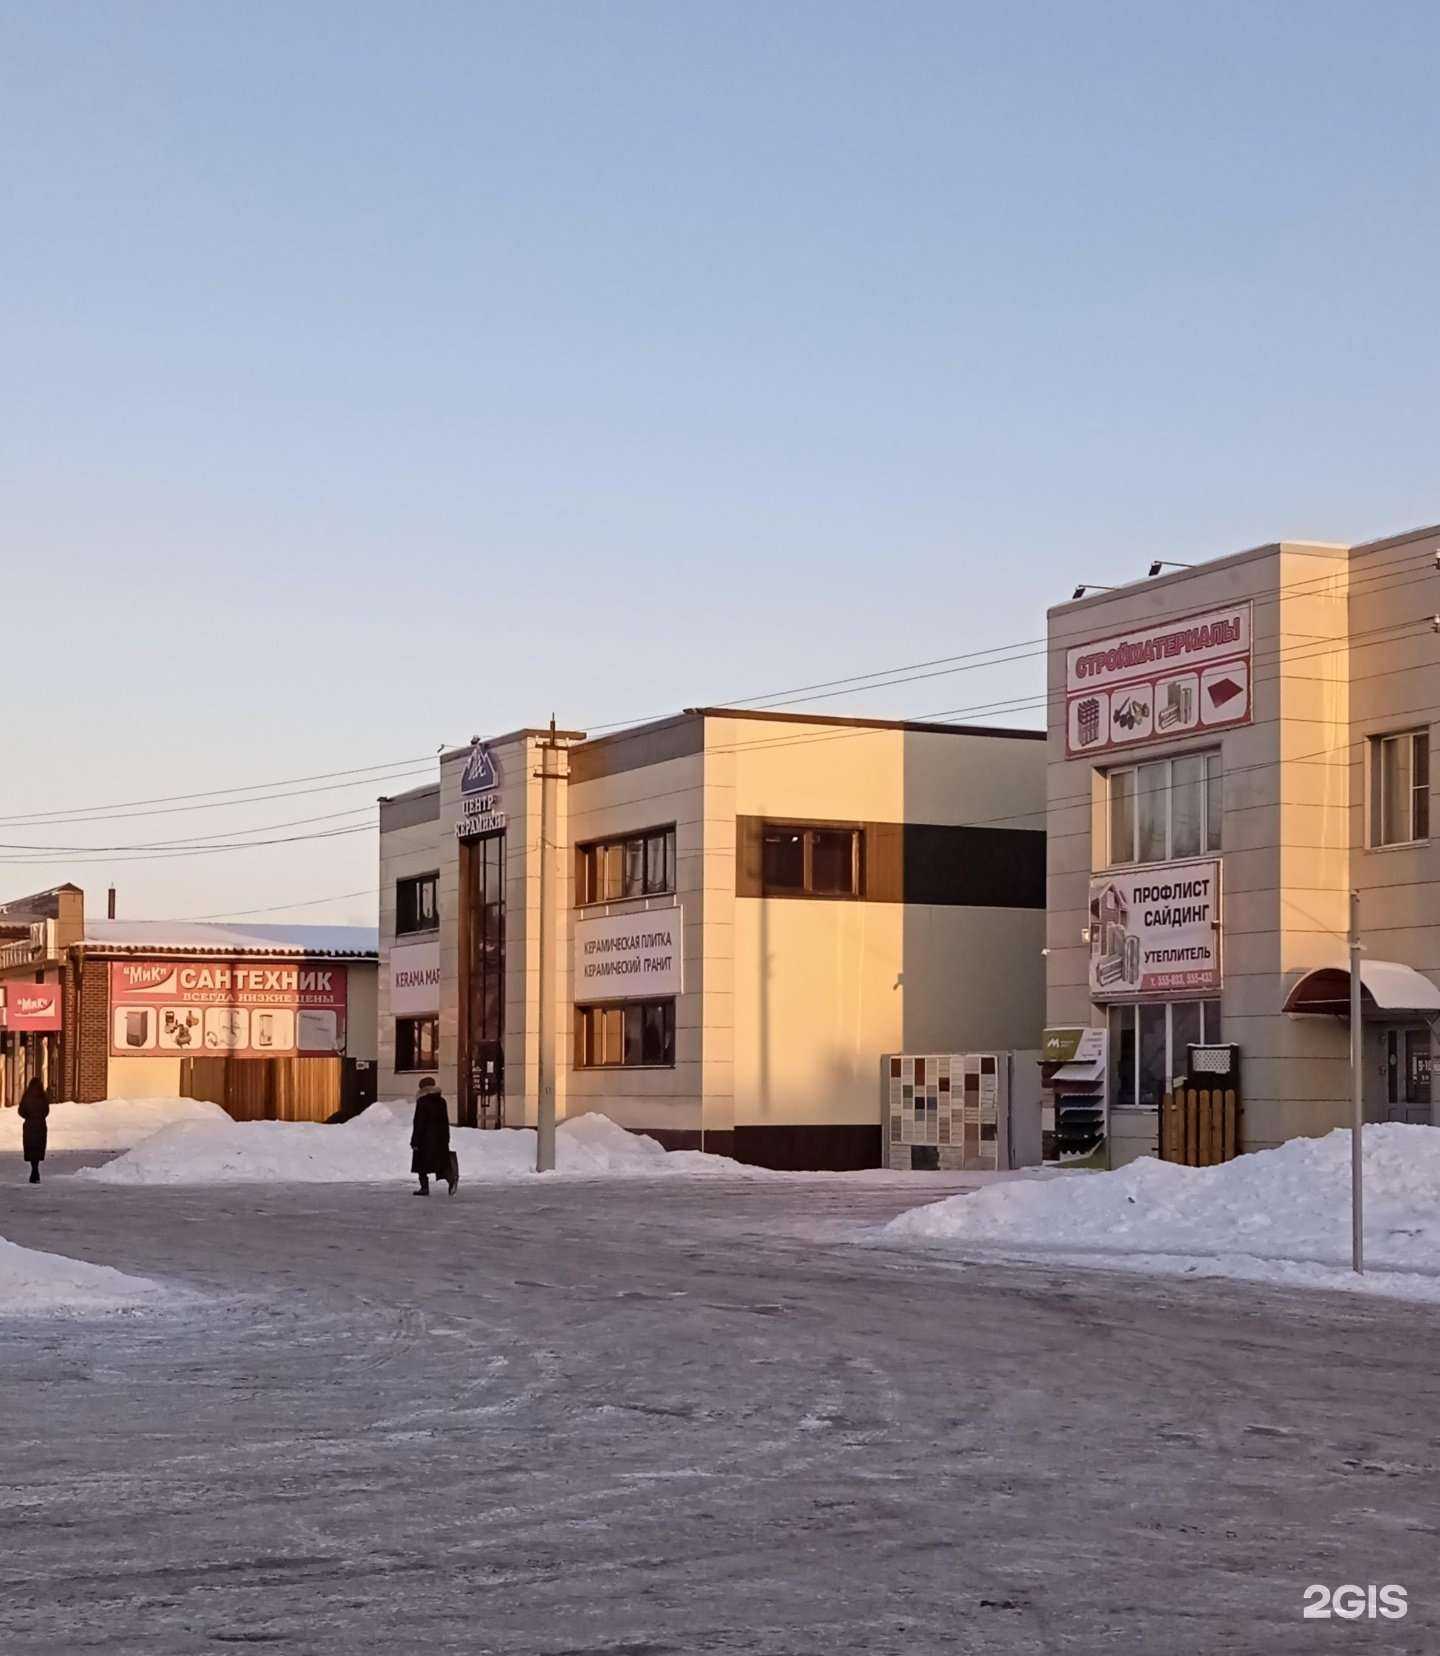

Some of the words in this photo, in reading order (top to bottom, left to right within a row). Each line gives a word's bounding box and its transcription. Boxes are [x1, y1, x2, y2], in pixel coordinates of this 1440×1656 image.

[1076, 617, 1241, 679] СТРОЙМАТЕРИАЛЫ
[463, 795, 494, 813] ЦЕНТР
[1133, 879, 1210, 903] ПРОФЛИСТ
[1144, 904, 1210, 928] САЙДИНГ
[584, 935, 640, 954] КЕРАМИЧЕСКАЯ
[641, 932, 672, 949] ПЛИТКА
[1144, 946, 1211, 964] УТЕПЛИТЕЛЬ
[584, 956, 641, 977] КЕРАМИЧЕСКИЙ
[643, 957, 672, 973] ГРАНИТ
[180, 968, 333, 991] САНТЕХНИК
[396, 970, 425, 987] KERAMA
[183, 992, 235, 1003] ВСЕГДА
[238, 993, 293, 1003] НИЗКИЕ
[296, 994, 335, 1004] ЦЕНЫ
